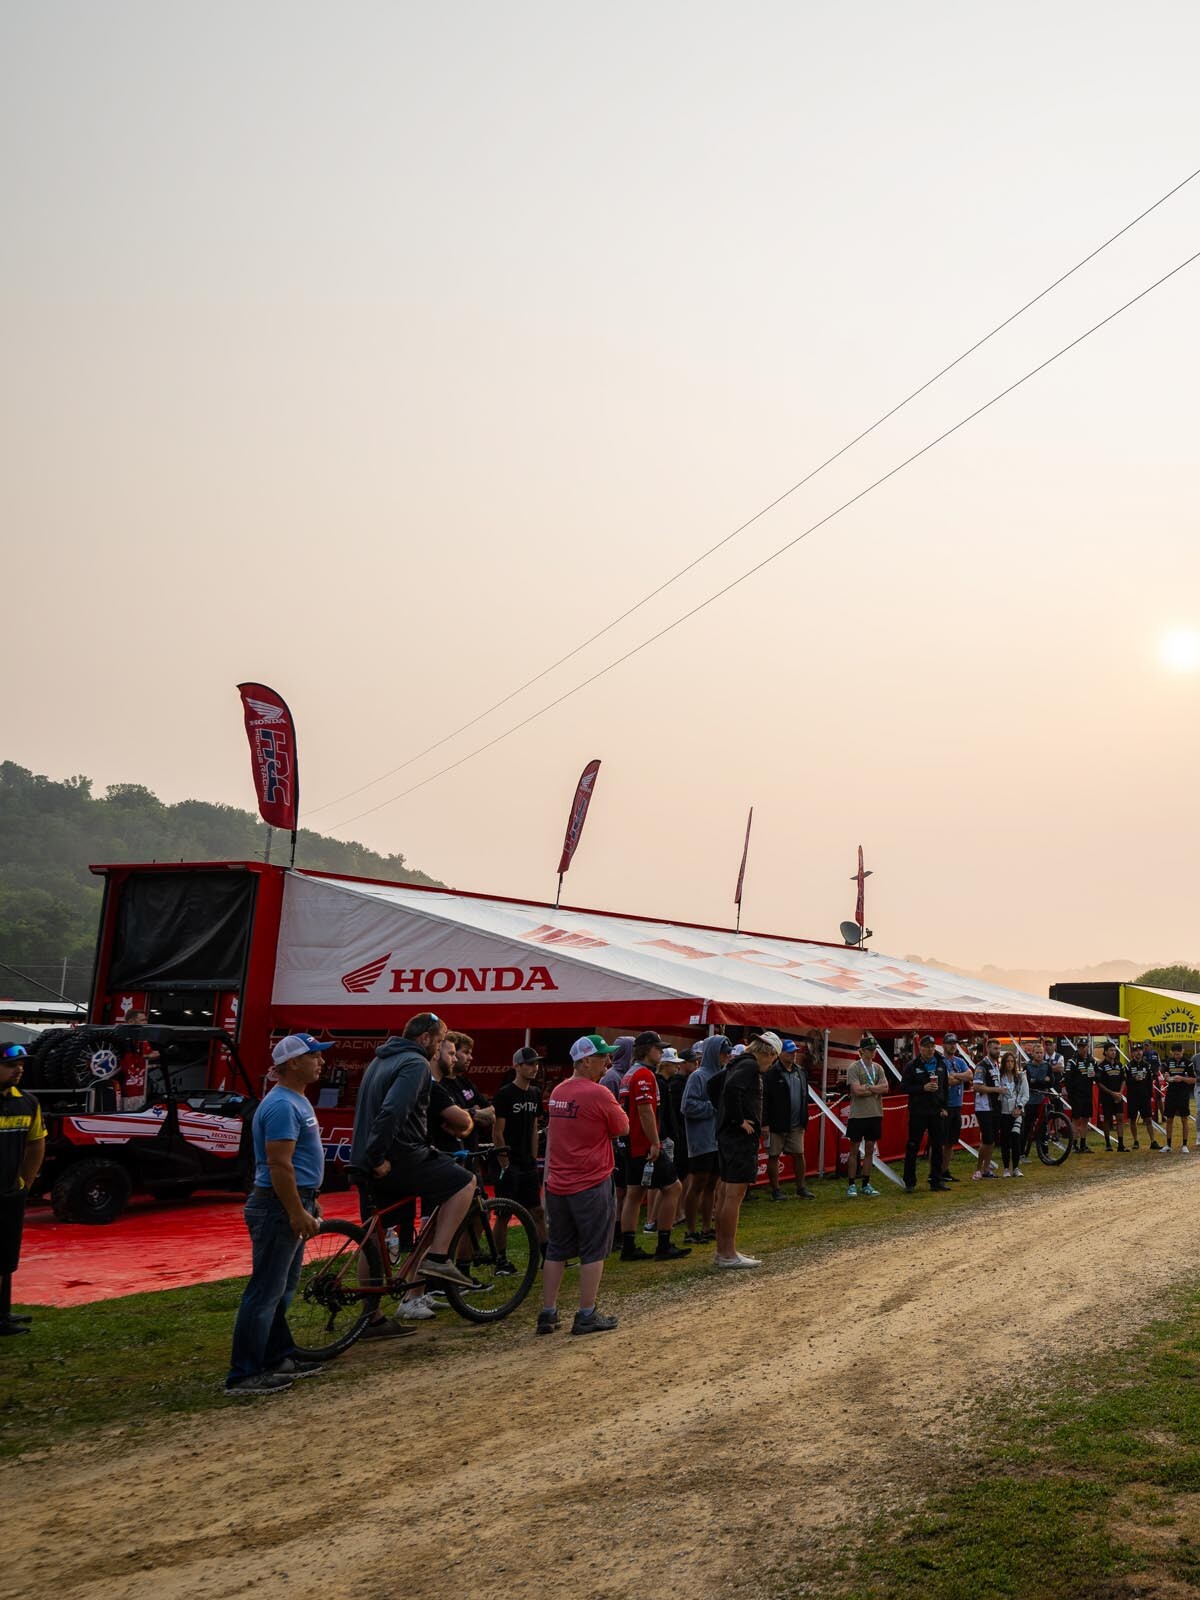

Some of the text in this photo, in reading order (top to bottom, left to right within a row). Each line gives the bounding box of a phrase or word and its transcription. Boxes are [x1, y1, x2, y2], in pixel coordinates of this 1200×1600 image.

[249, 718, 287, 726] HONDA
[389, 966, 559, 993] HONDA
[1148, 1022, 1187, 1038] TWISTED
[468, 1064, 513, 1074] DUNLO
[211, 1132, 237, 1140] HONDA
